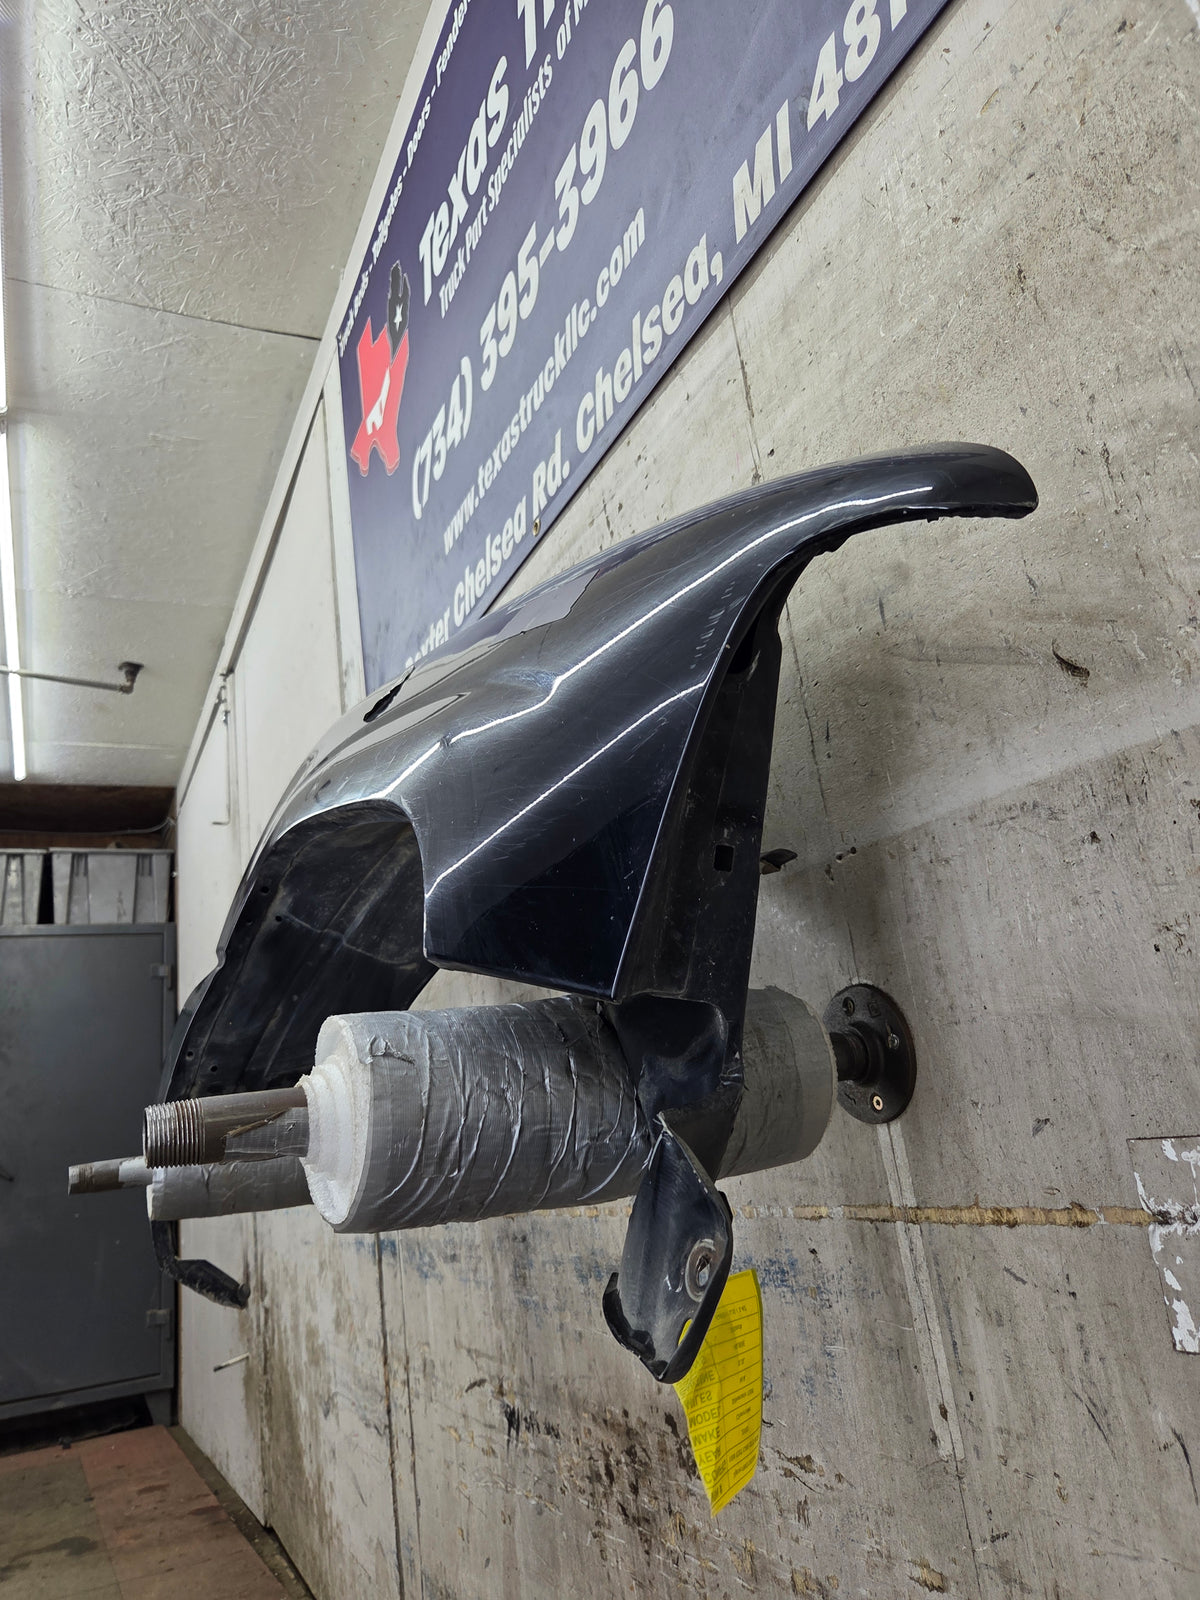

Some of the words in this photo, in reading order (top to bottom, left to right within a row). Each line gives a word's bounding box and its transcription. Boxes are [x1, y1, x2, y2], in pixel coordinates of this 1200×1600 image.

[407, 96, 431, 169] Doors
[436, 0, 471, 87] Fender
[418, 55, 509, 307] Texas
[517, 0, 555, 70] T
[438, 246, 466, 319] Truck
[466, 195, 489, 264] Part
[488, 53, 553, 212] Specialists
[556, 0, 572, 61] of
[411, 356, 473, 521] (734)
[480, 0, 675, 392] 395-3966
[442, 207, 646, 556] www.texastruckllc.com
[453, 489, 528, 627] Chelsea
[532, 426, 571, 522] Rd.
[575, 231, 724, 454] Chelsea,
[732, 98, 793, 245] MI
